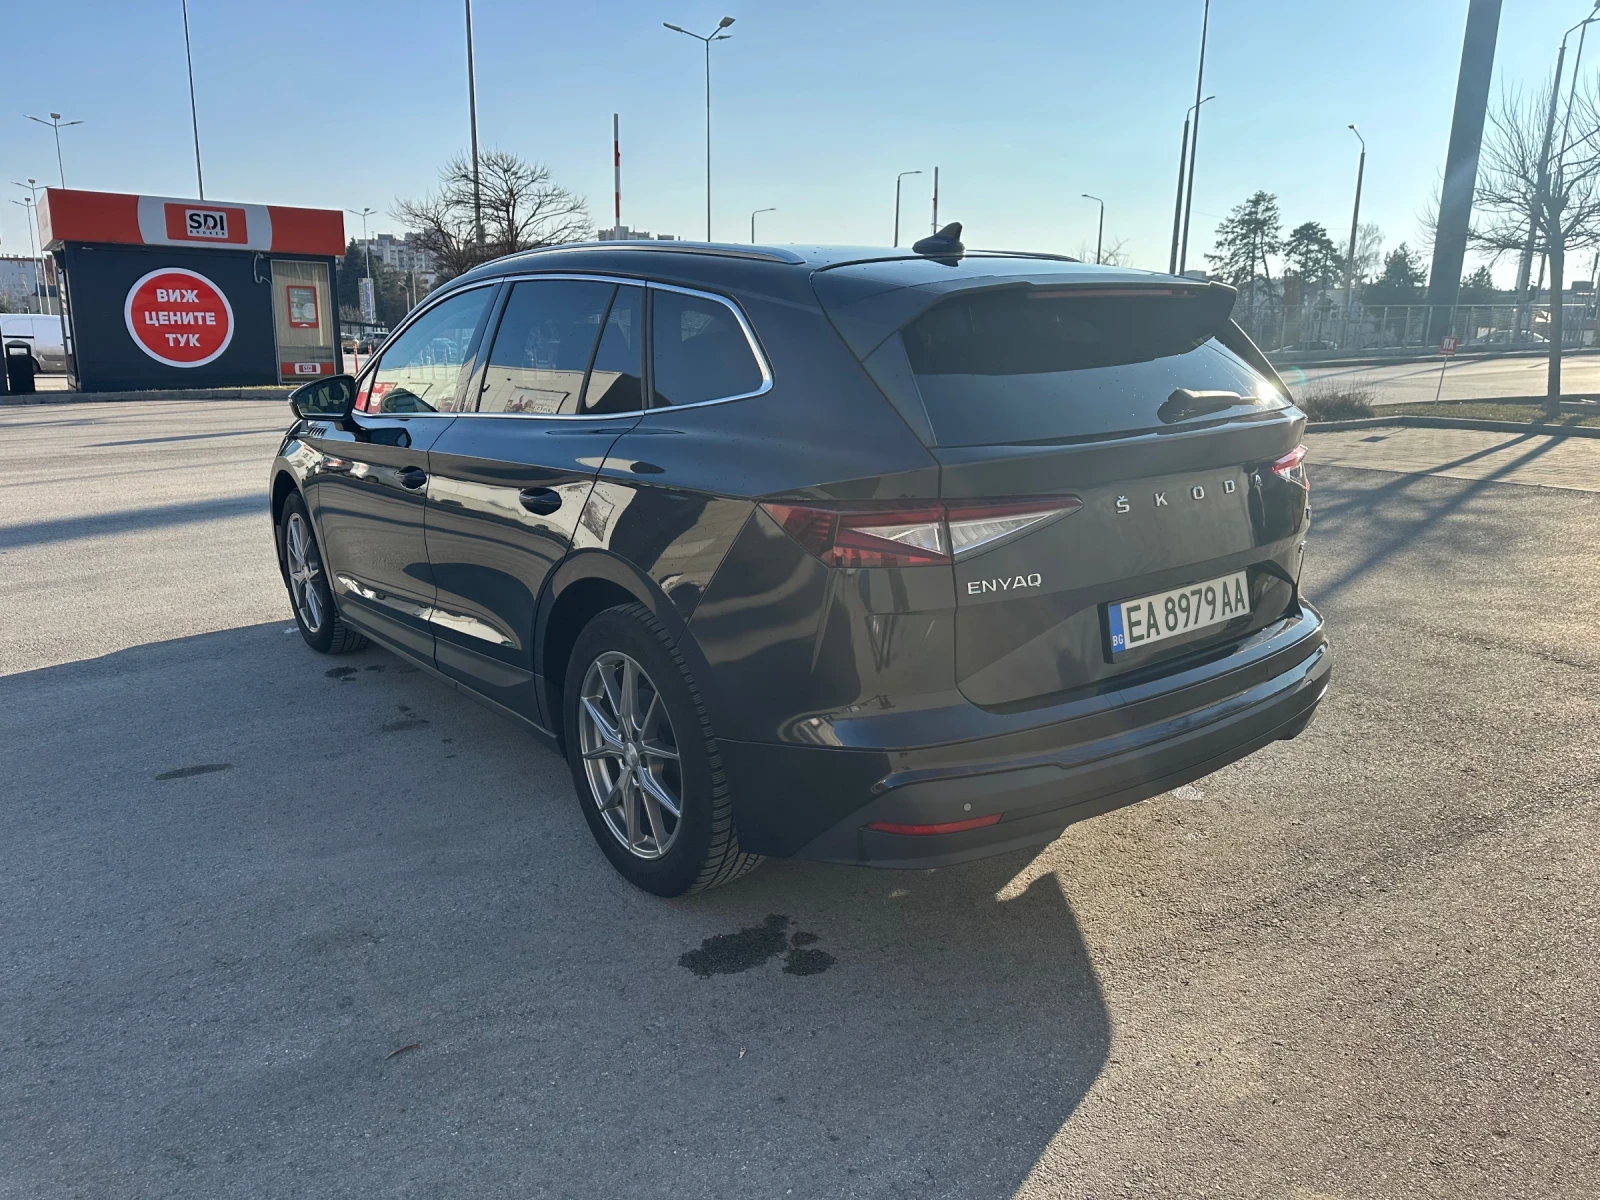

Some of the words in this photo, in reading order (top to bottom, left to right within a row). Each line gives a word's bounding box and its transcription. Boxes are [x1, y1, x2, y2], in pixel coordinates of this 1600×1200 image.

[188, 213, 225, 231] SDI
[156, 288, 199, 303] ВИЖ
[144, 311, 216, 327] ЦЕНИТЕ
[165, 333, 201, 347] ТУК
[1115, 474, 1263, 514] ŠKODA
[967, 573, 1042, 595] ENYAQ
[1112, 634, 1124, 647] BG
